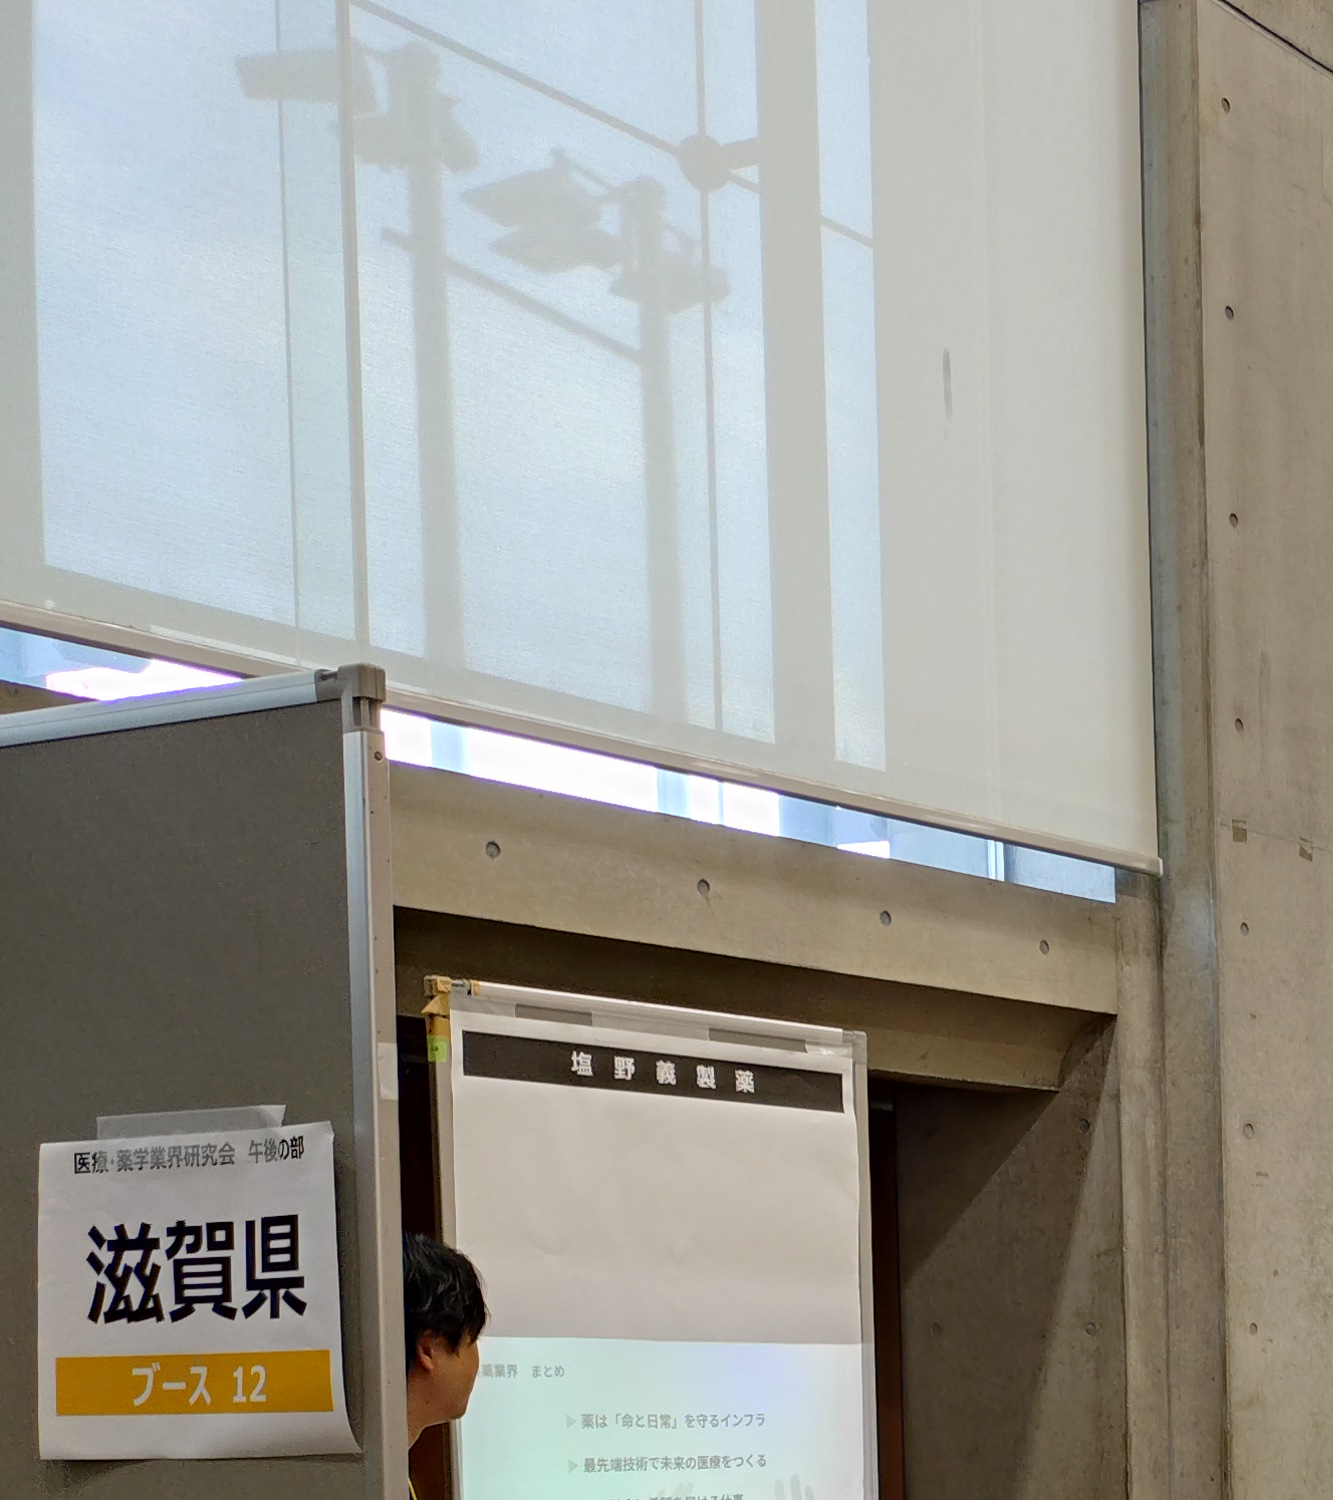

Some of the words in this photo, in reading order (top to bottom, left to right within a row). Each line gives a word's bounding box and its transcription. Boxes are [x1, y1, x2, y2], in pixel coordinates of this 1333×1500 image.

[571, 1050, 756, 1094] 塩野義製薬
[74, 1142, 236, 1175] 医療・薬学業界研究会
[248, 1135, 304, 1165] 午後の部
[86, 1214, 307, 1324] 滋賀県
[132, 1362, 212, 1406] ブース
[232, 1365, 267, 1403] 12
[478, 1364, 518, 1379] 薬業界
[531, 1364, 565, 1379] まとめ
[580, 1412, 766, 1430] 薬は「命と日常」を守るインフラ
[583, 1454, 767, 1474] 最先端技術で未来の医療をつくる
